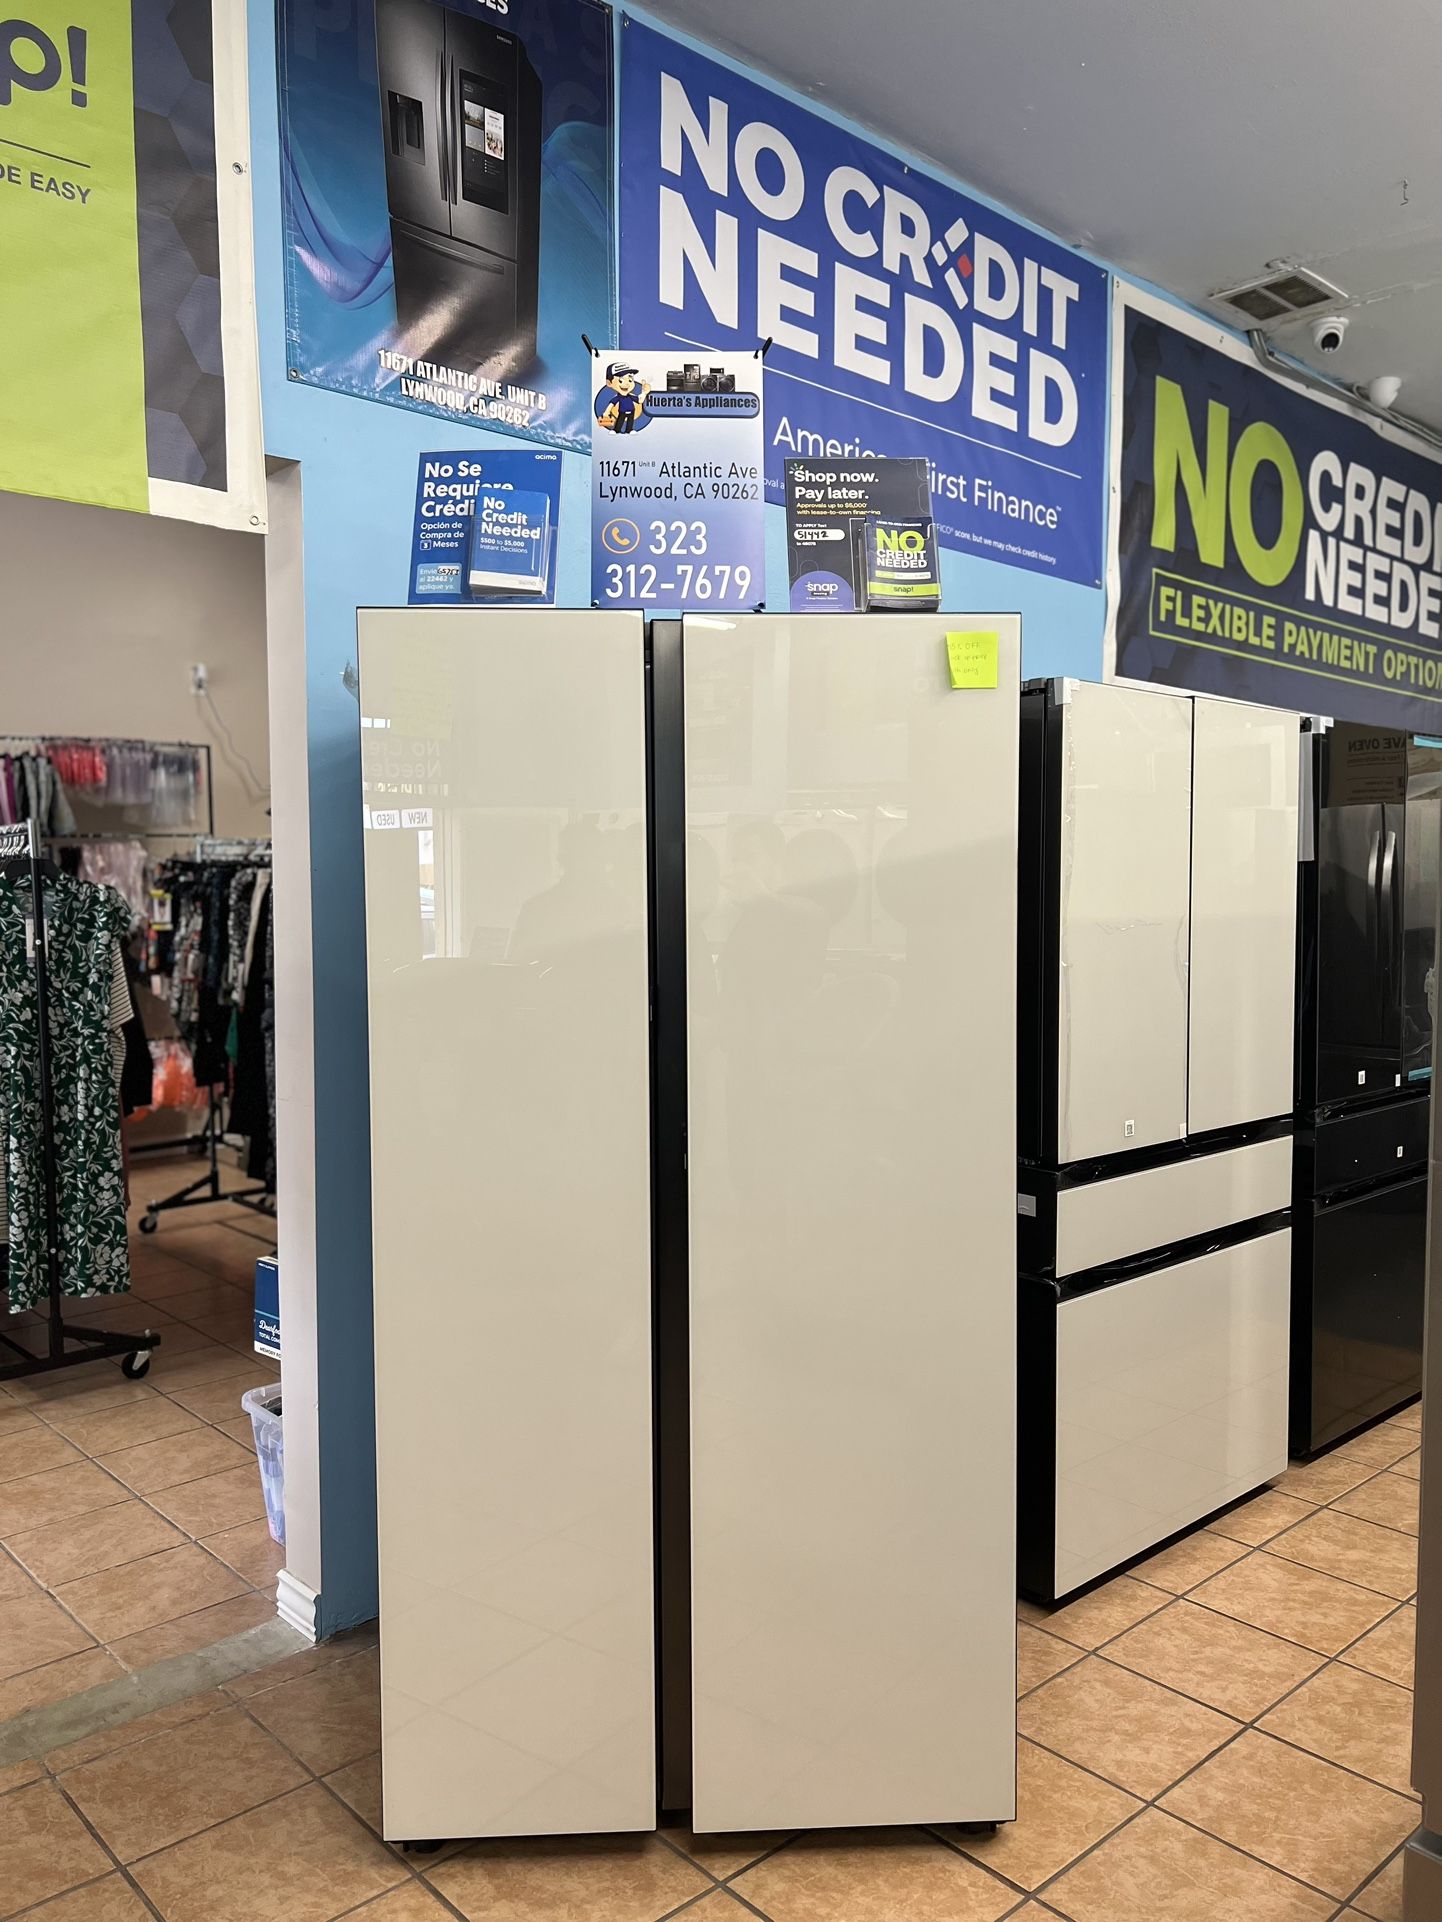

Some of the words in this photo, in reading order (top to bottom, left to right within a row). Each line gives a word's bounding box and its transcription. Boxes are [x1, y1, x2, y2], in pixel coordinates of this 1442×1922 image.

[660, 71, 805, 221] NO
[30, 171, 91, 205] EASY
[659, 185, 1078, 447] NEEDED
[378, 349, 414, 375] 11671
[416, 360, 477, 392] ATLANTIC
[507, 385, 536, 407] UNIT
[538, 393, 547, 410] B
[401, 377, 466, 413] LYNWOOD,
[470, 397, 487, 417] CA
[489, 401, 531, 427] 90262
[646, 395, 692, 408] Huerta's
[694, 396, 758, 409] Appliances
[773, 416, 887, 458] Ameri
[926, 462, 967, 502] irst
[424, 462, 453, 479] No
[457, 461, 482, 477] Se
[599, 460, 637, 477] 11671
[659, 461, 722, 478] Atlantic
[727, 462, 758, 479] Ave
[794, 470, 837, 484] Shop
[840, 472, 879, 483] now.
[423, 479, 513, 499] Requi
[1150, 375, 1304, 587] NO
[599, 482, 677, 503] Lynwood,
[683, 483, 705, 499] CA
[712, 484, 759, 500] 90262
[795, 487, 825, 502] Pay
[828, 487, 869, 499] later.
[483, 496, 505, 510] No
[420, 522, 450, 531] Opción
[482, 509, 528, 525] Credit
[420, 532, 451, 540] Compra
[481, 522, 541, 539] Needed
[649, 520, 708, 555] 323
[876, 528, 924, 552] NO
[480, 543, 499, 551] Instant
[500, 545, 529, 554] Decisions
[876, 549, 926, 559] CREDIT
[972, 533, 983, 543] but
[983, 537, 992, 546] we
[993, 540, 1005, 551] may
[1005, 544, 1022, 555] check
[1022, 548, 1038, 559] credit
[877, 558, 928, 568] NEEDED
[605, 563, 751, 600] 312-7679
[807, 583, 839, 594] snap
[1159, 587, 1275, 650] FLEXIBLE
[1283, 622, 1377, 675] PAYMENT
